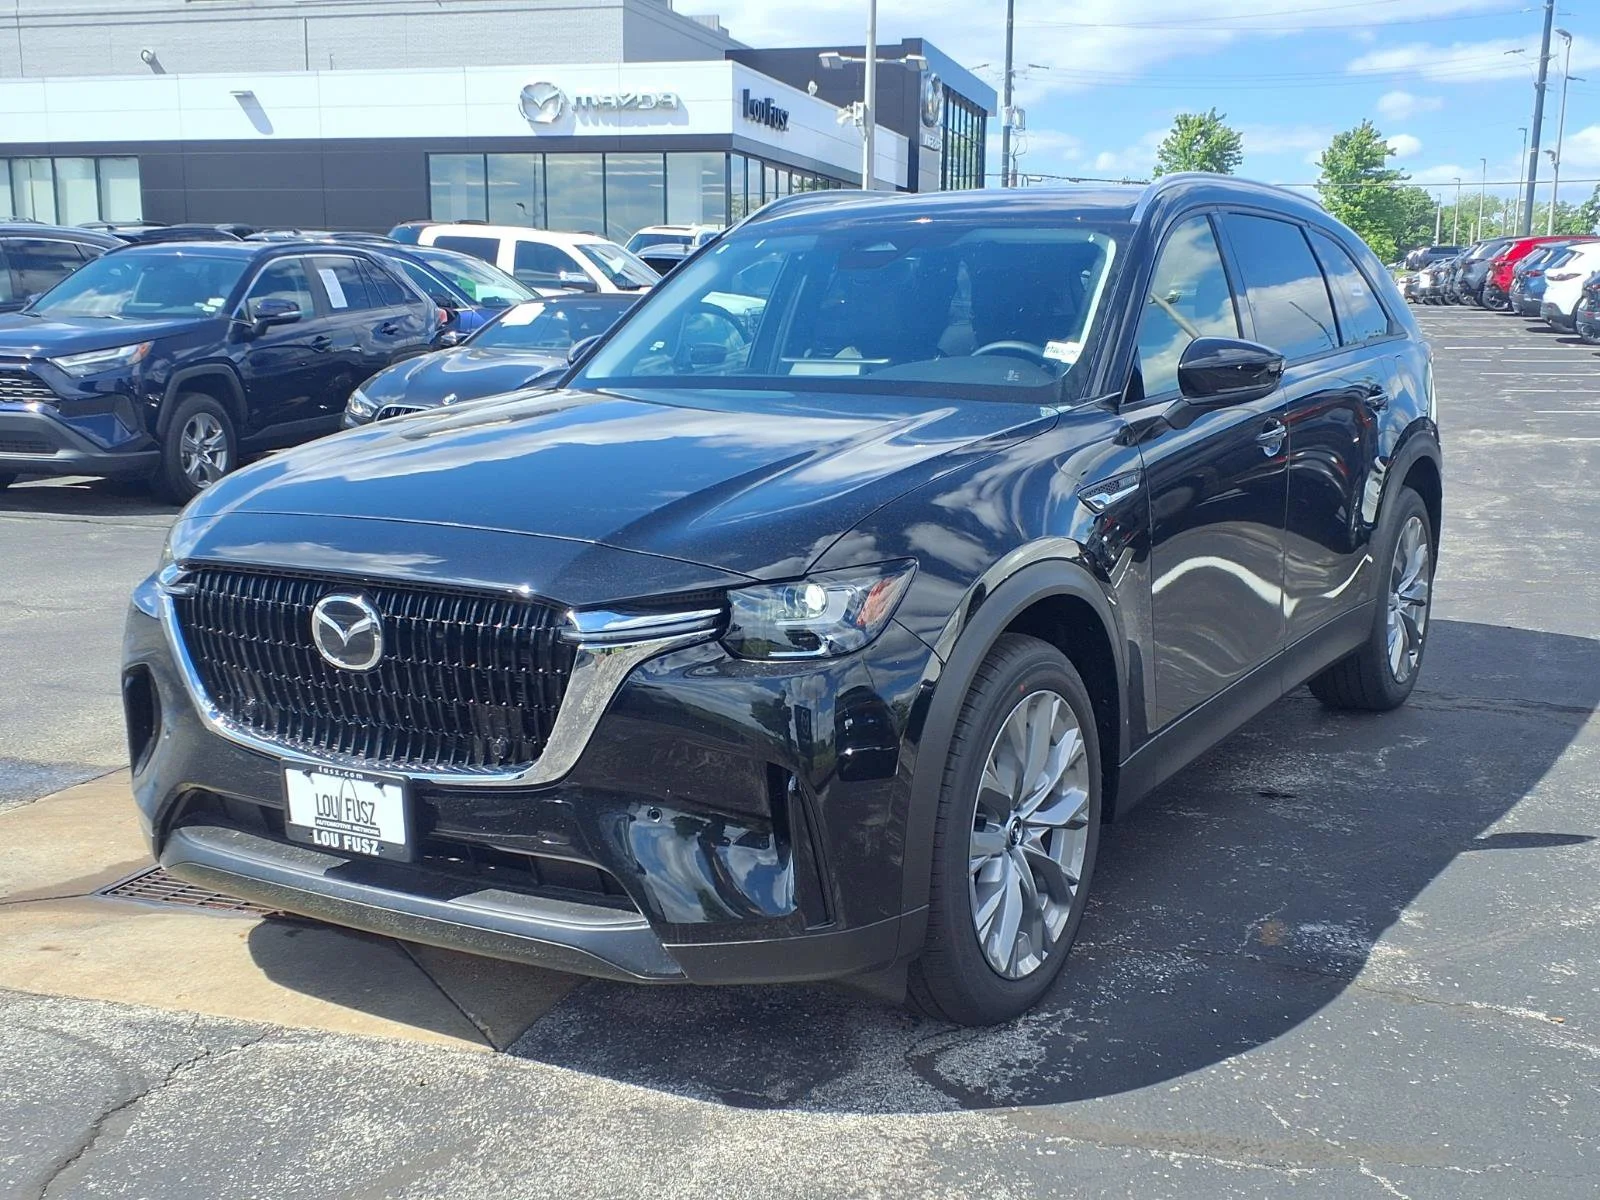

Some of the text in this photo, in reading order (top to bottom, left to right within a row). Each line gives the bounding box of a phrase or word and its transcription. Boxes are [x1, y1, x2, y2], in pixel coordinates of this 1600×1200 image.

[315, 793, 377, 826] LOU FUSZ
[312, 828, 380, 856] LOU FUSZ
